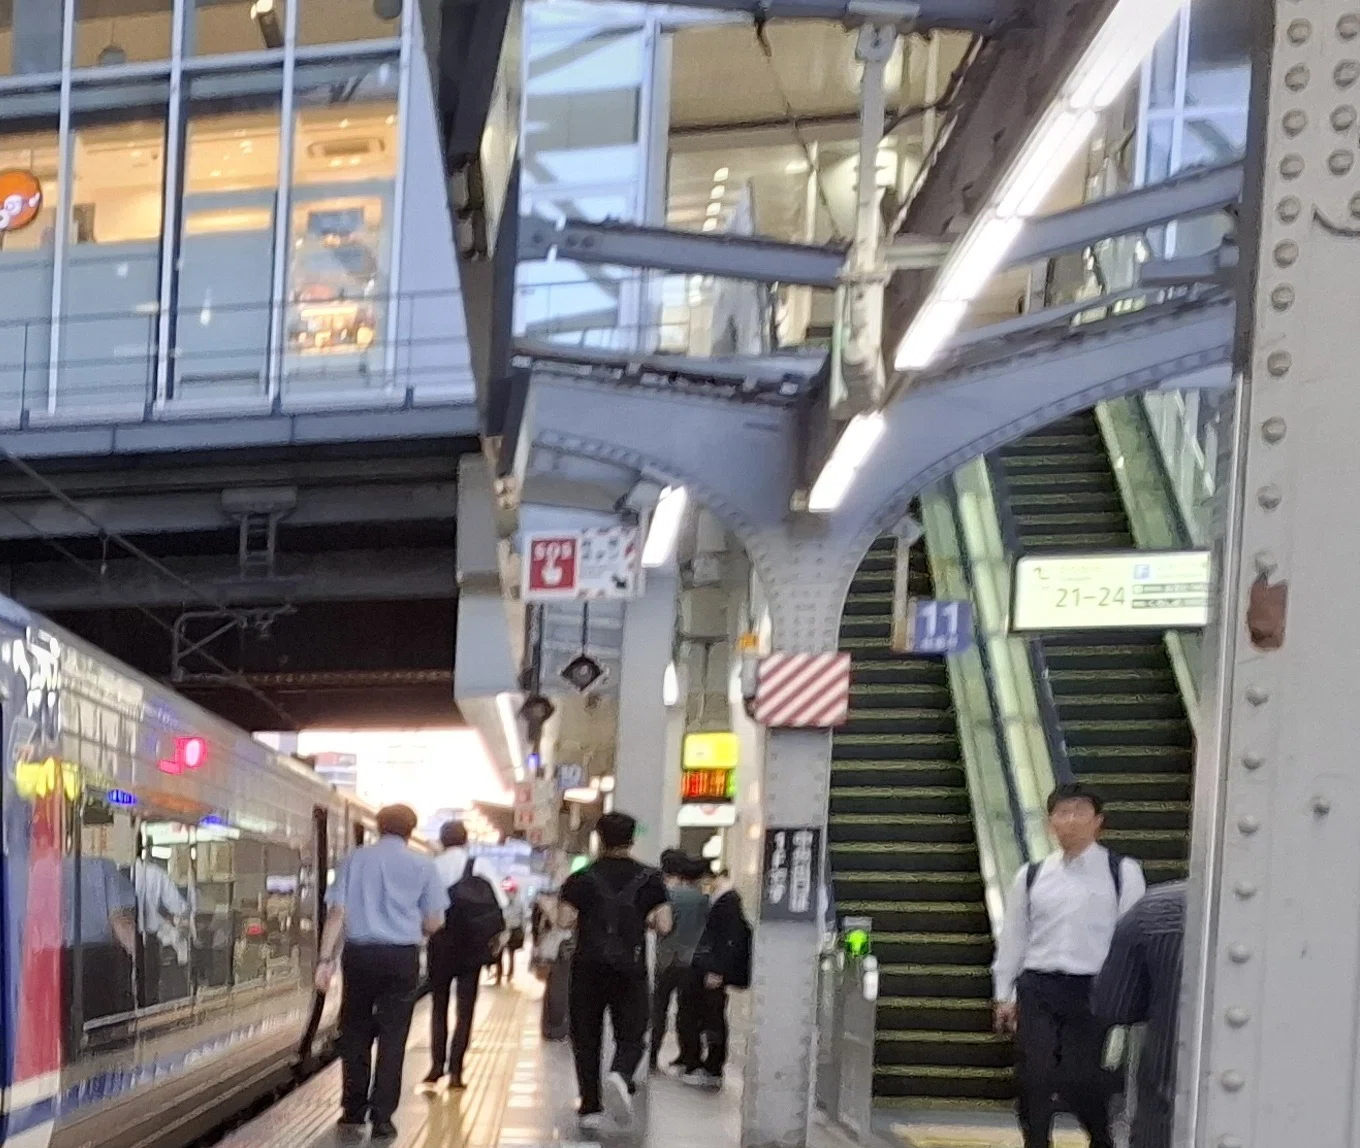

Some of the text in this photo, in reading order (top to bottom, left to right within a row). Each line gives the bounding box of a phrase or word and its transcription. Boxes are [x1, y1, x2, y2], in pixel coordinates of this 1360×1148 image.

[534, 541, 572, 560] SOS
[1055, 587, 1125, 608] 21-24
[921, 601, 958, 637] 11
